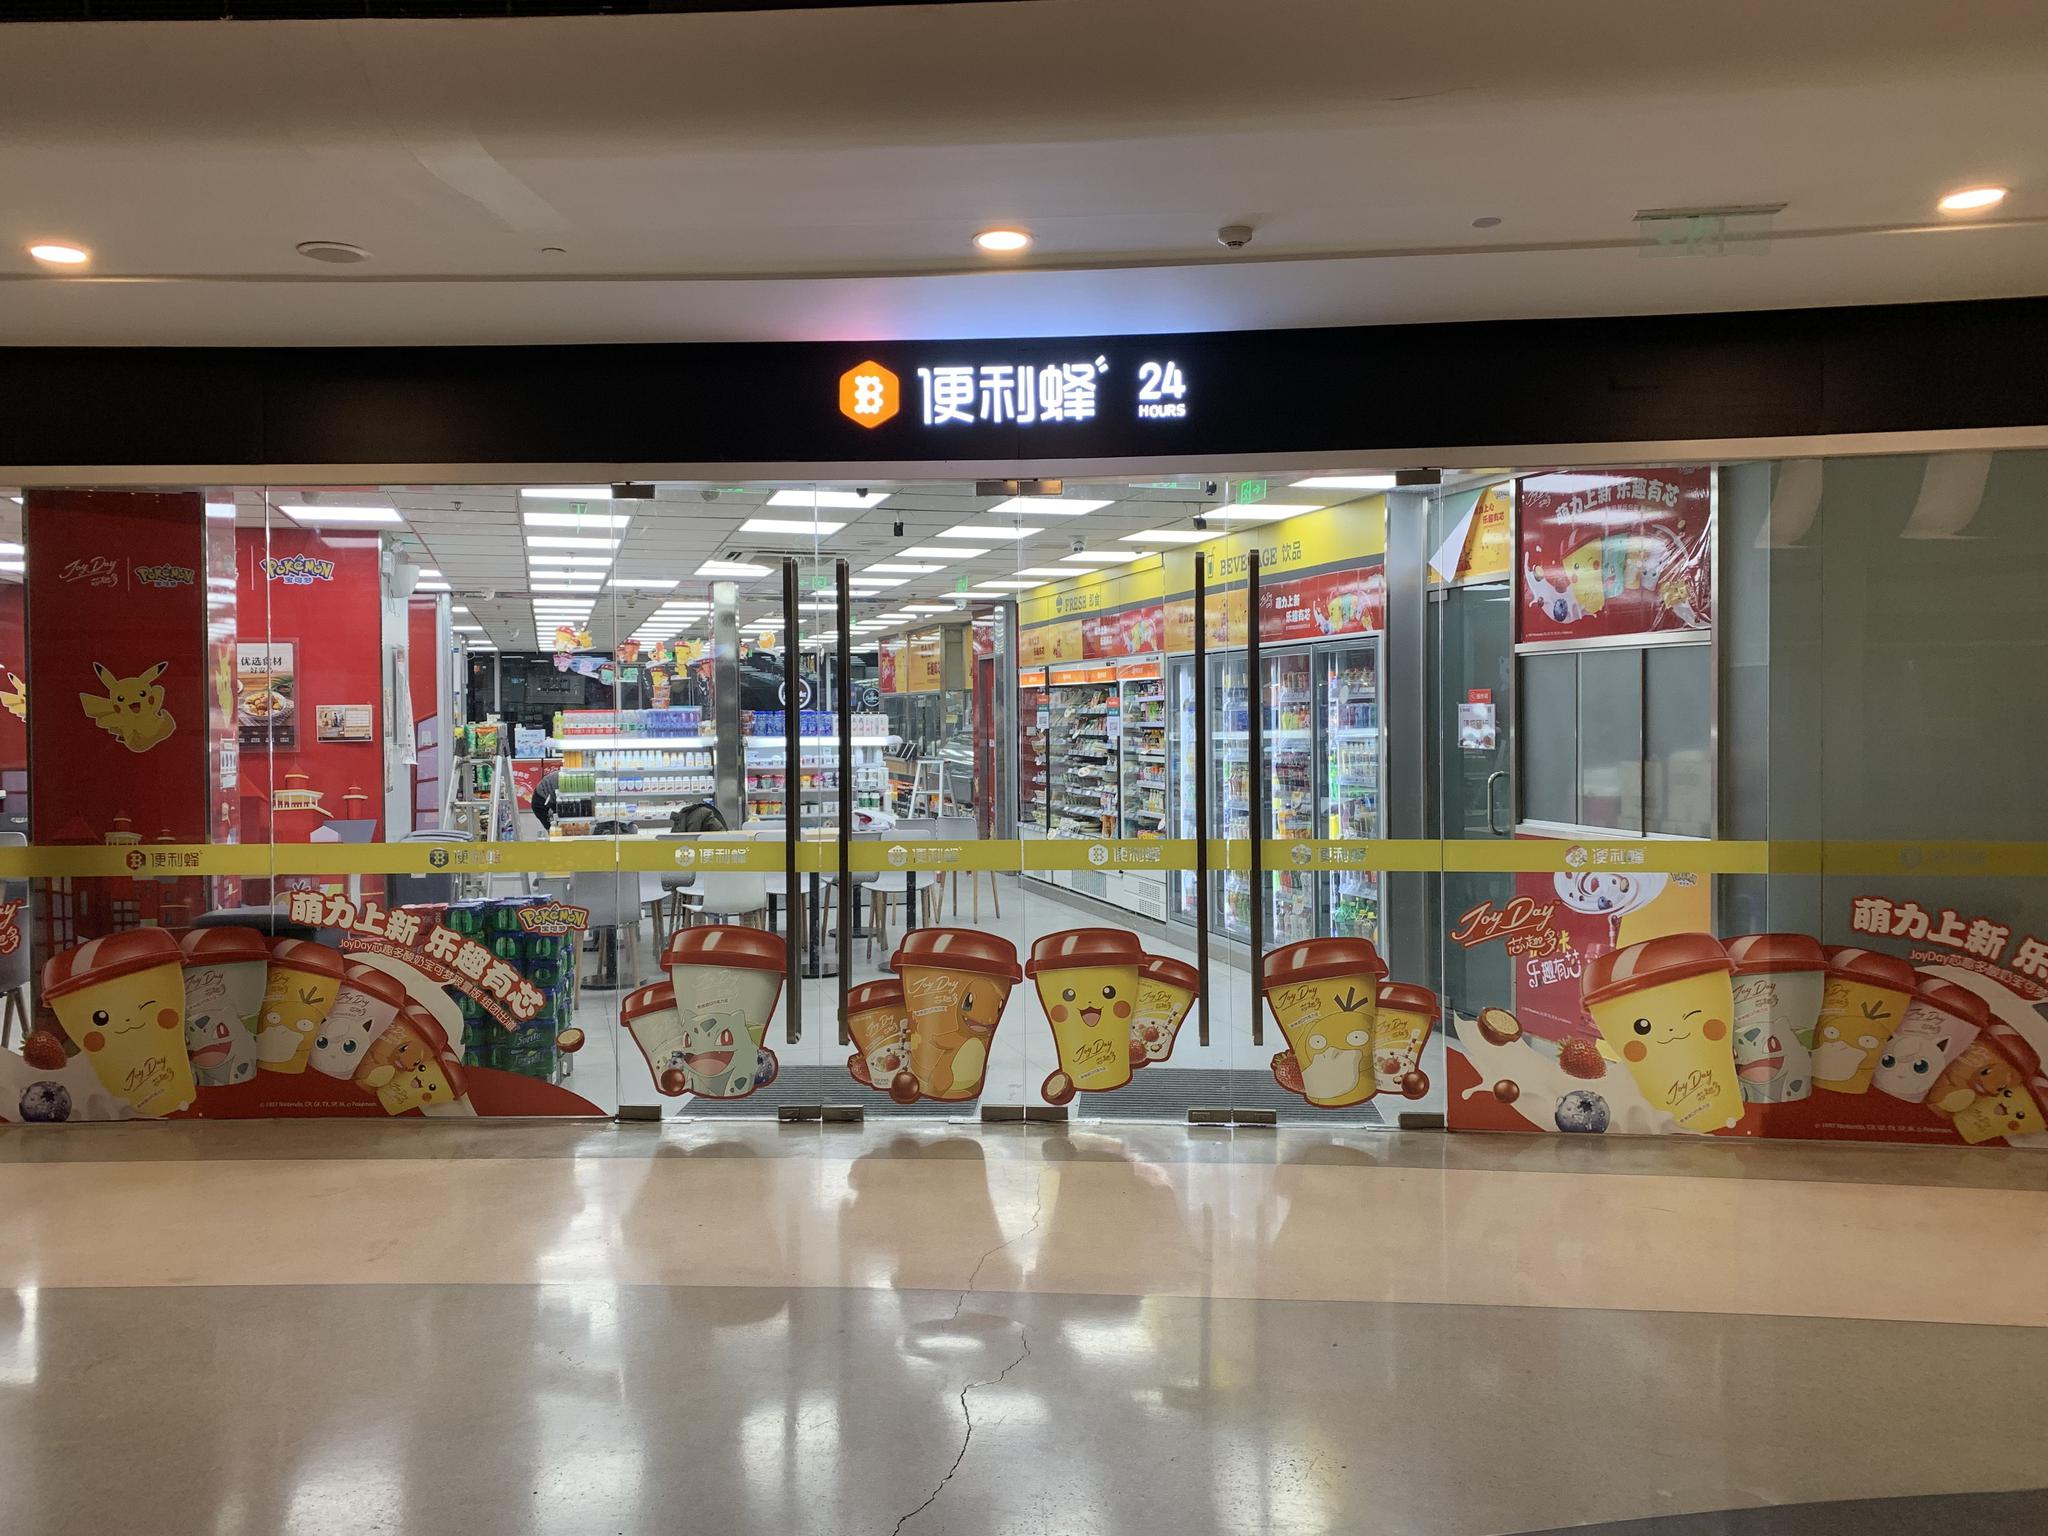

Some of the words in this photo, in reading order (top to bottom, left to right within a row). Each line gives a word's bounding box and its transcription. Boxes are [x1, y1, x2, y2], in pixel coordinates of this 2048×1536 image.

[917, 356, 1110, 426] 便利蜂
[1138, 361, 1187, 400] 24
[1138, 403, 1187, 419] HOURS
[1617, 477, 1681, 508] 乐趣有芯
[1220, 547, 1278, 577] BEVEAGE
[1282, 541, 1302, 562] 饮品
[1065, 594, 1087, 612] FRESH
[240, 655, 283, 667] 优选食材
[150, 849, 204, 868] 便利蜂
[1452, 901, 1503, 938] Joy
[1501, 896, 1555, 932] Day
[1853, 896, 2011, 961] 萌力上新
[291, 891, 424, 946] 萌力上新
[424, 925, 546, 1019] 乐趣有芯
[1507, 928, 1557, 957] 芯趣多
[908, 976, 935, 994] Joy
[936, 975, 961, 991] Day
[1526, 950, 1582, 989] 乐趣有芯
[1275, 989, 1299, 1009] Joy
[1298, 984, 1319, 1001] Day
[1753, 979, 1777, 997] Day
[1073, 1045, 1093, 1063] Joy
[1092, 1038, 1114, 1054] Day
[123, 1066, 145, 1093] Joy
[144, 1056, 167, 1077] Day
[1666, 1079, 1688, 1106] Joy
[1687, 1069, 1713, 1090] Day
